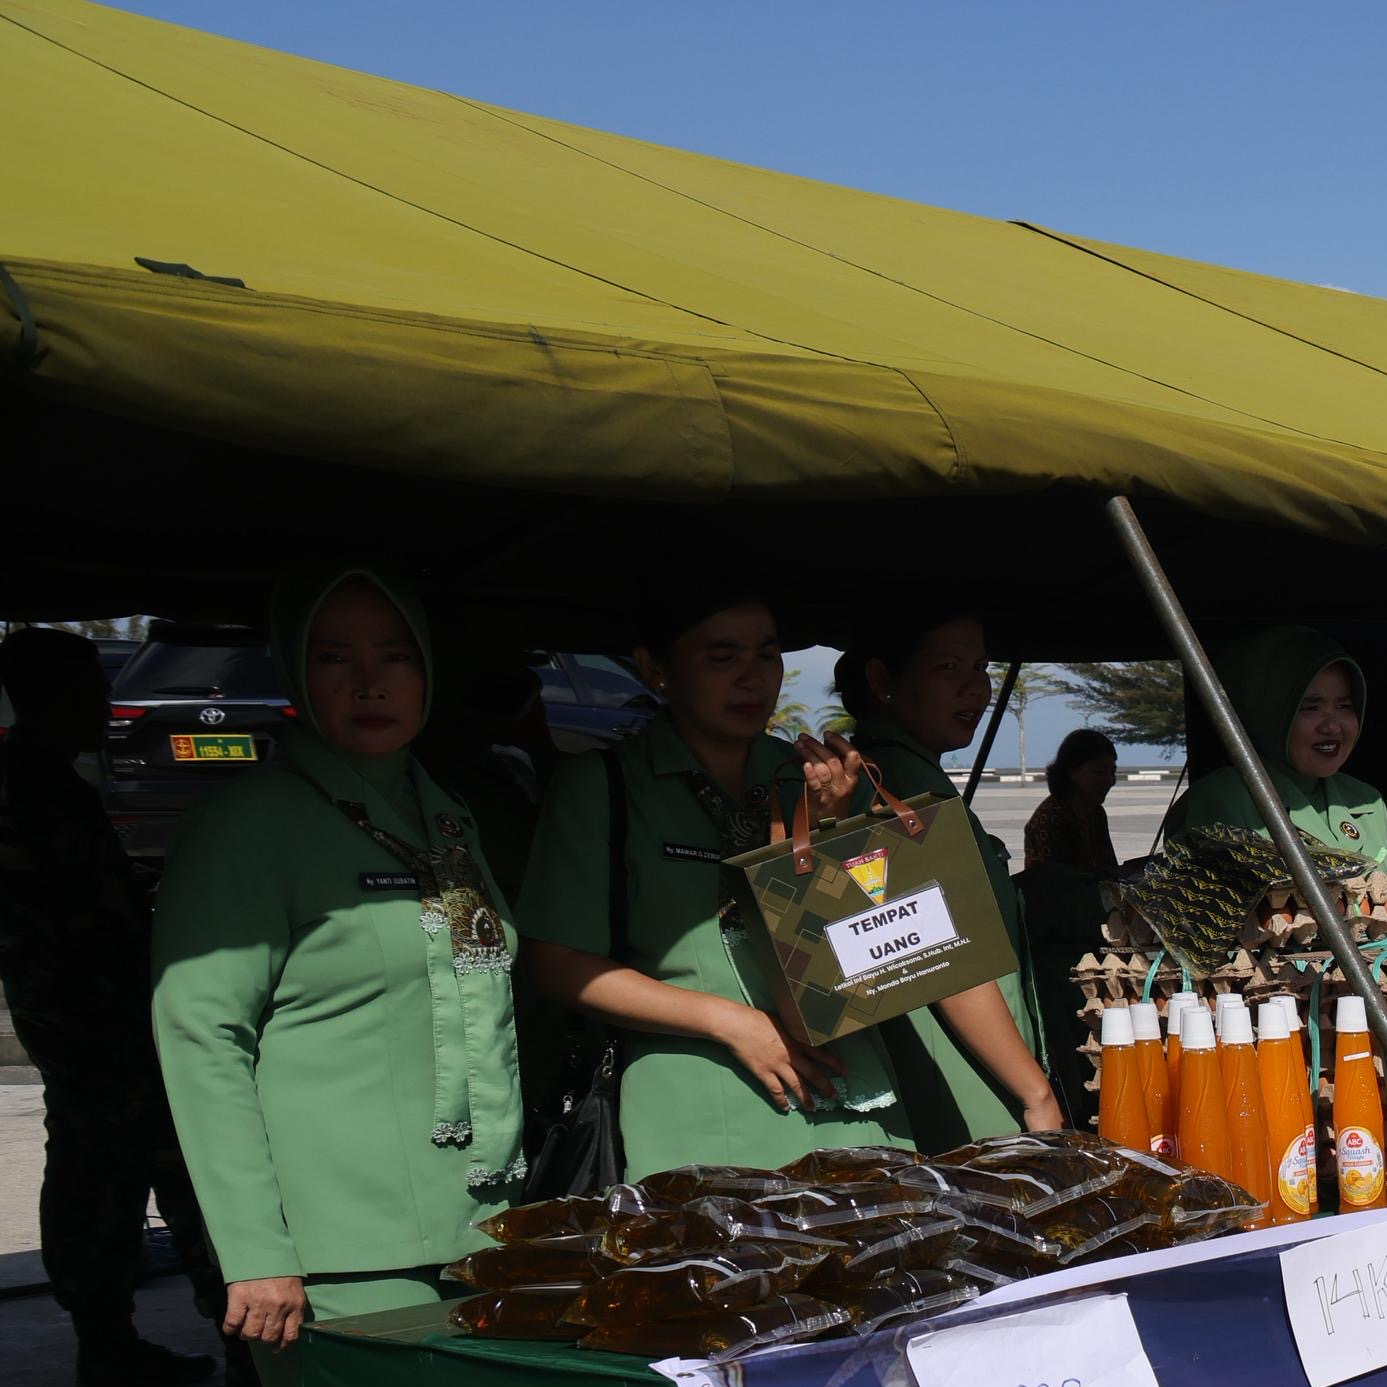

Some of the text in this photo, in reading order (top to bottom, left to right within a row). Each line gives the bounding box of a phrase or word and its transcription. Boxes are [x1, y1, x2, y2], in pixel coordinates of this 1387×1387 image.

[848, 900, 919, 936] TEMPAT
[869, 932, 921, 960] UANG
[862, 970, 880, 982] Bayu
